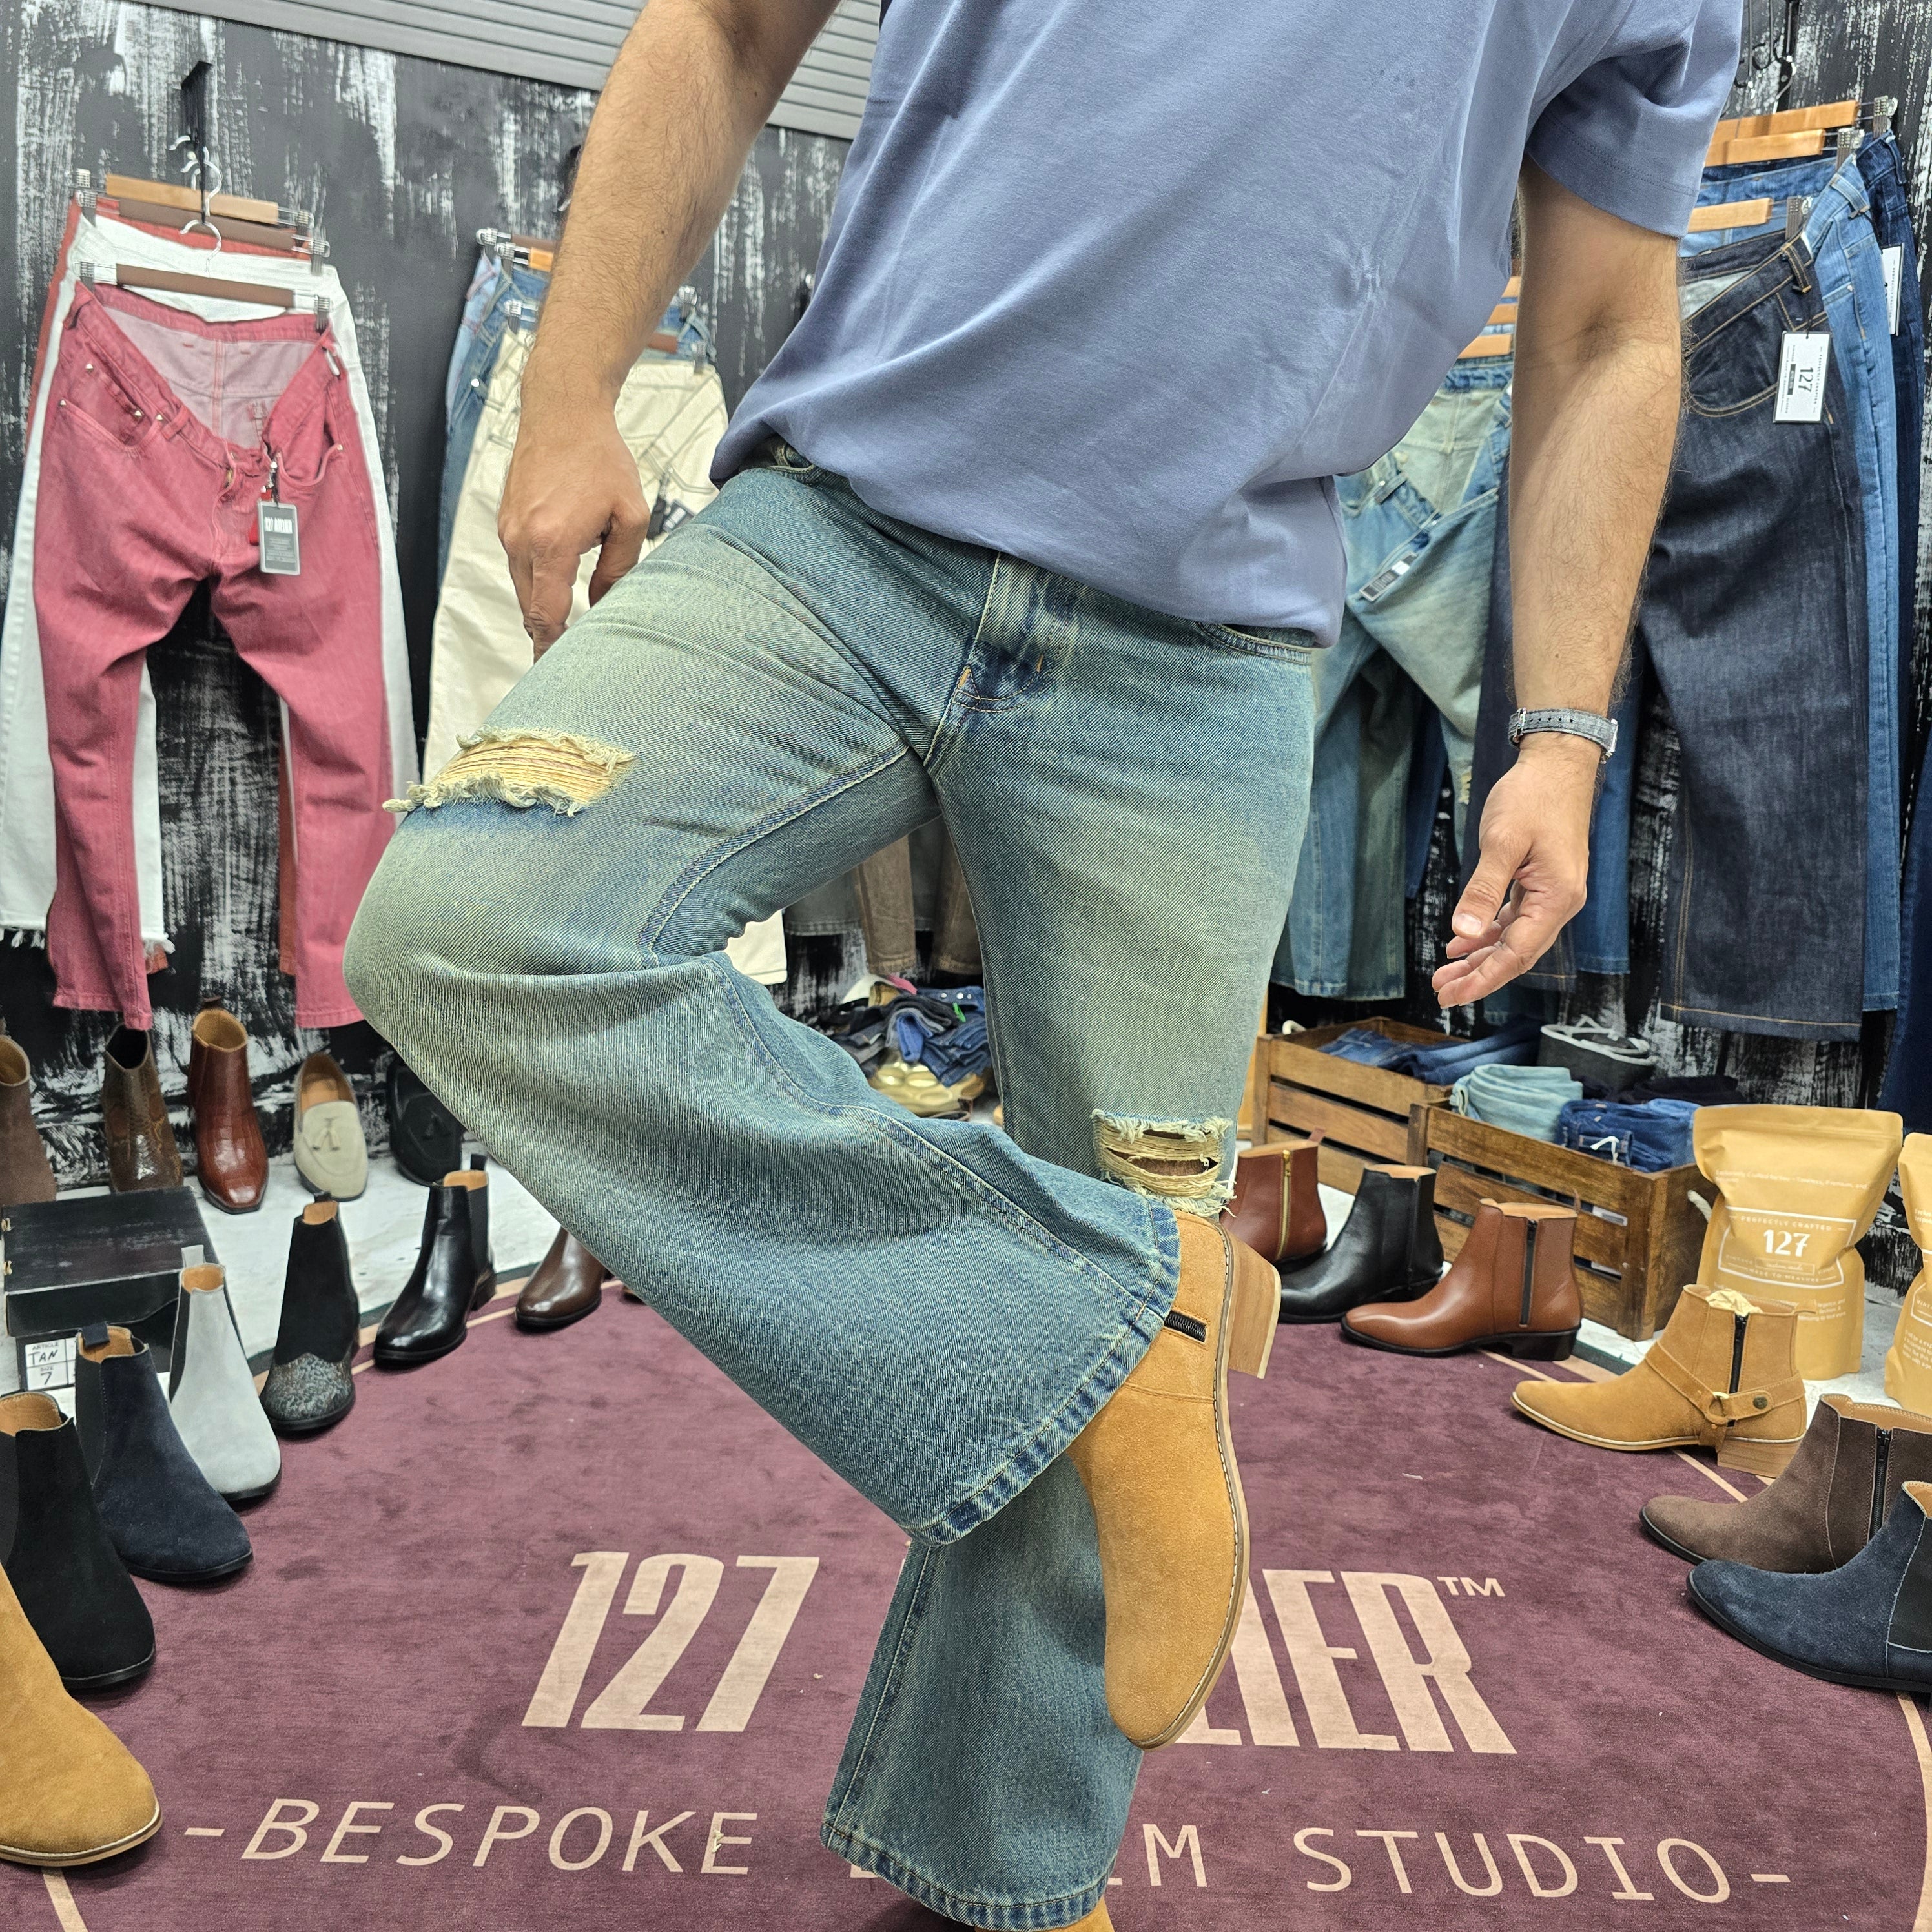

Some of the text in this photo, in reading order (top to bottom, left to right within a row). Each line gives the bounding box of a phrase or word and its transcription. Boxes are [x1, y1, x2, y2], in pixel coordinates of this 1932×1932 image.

[1798, 367, 1814, 393] 127
[1740, 1215, 1832, 1231] PERFECTLY CRAFTED
[1763, 1229, 1810, 1257] 127
[28, 1349, 58, 1365] TAN
[41, 1372, 52, 1385] 7
[521, 1550, 820, 1732] 127
